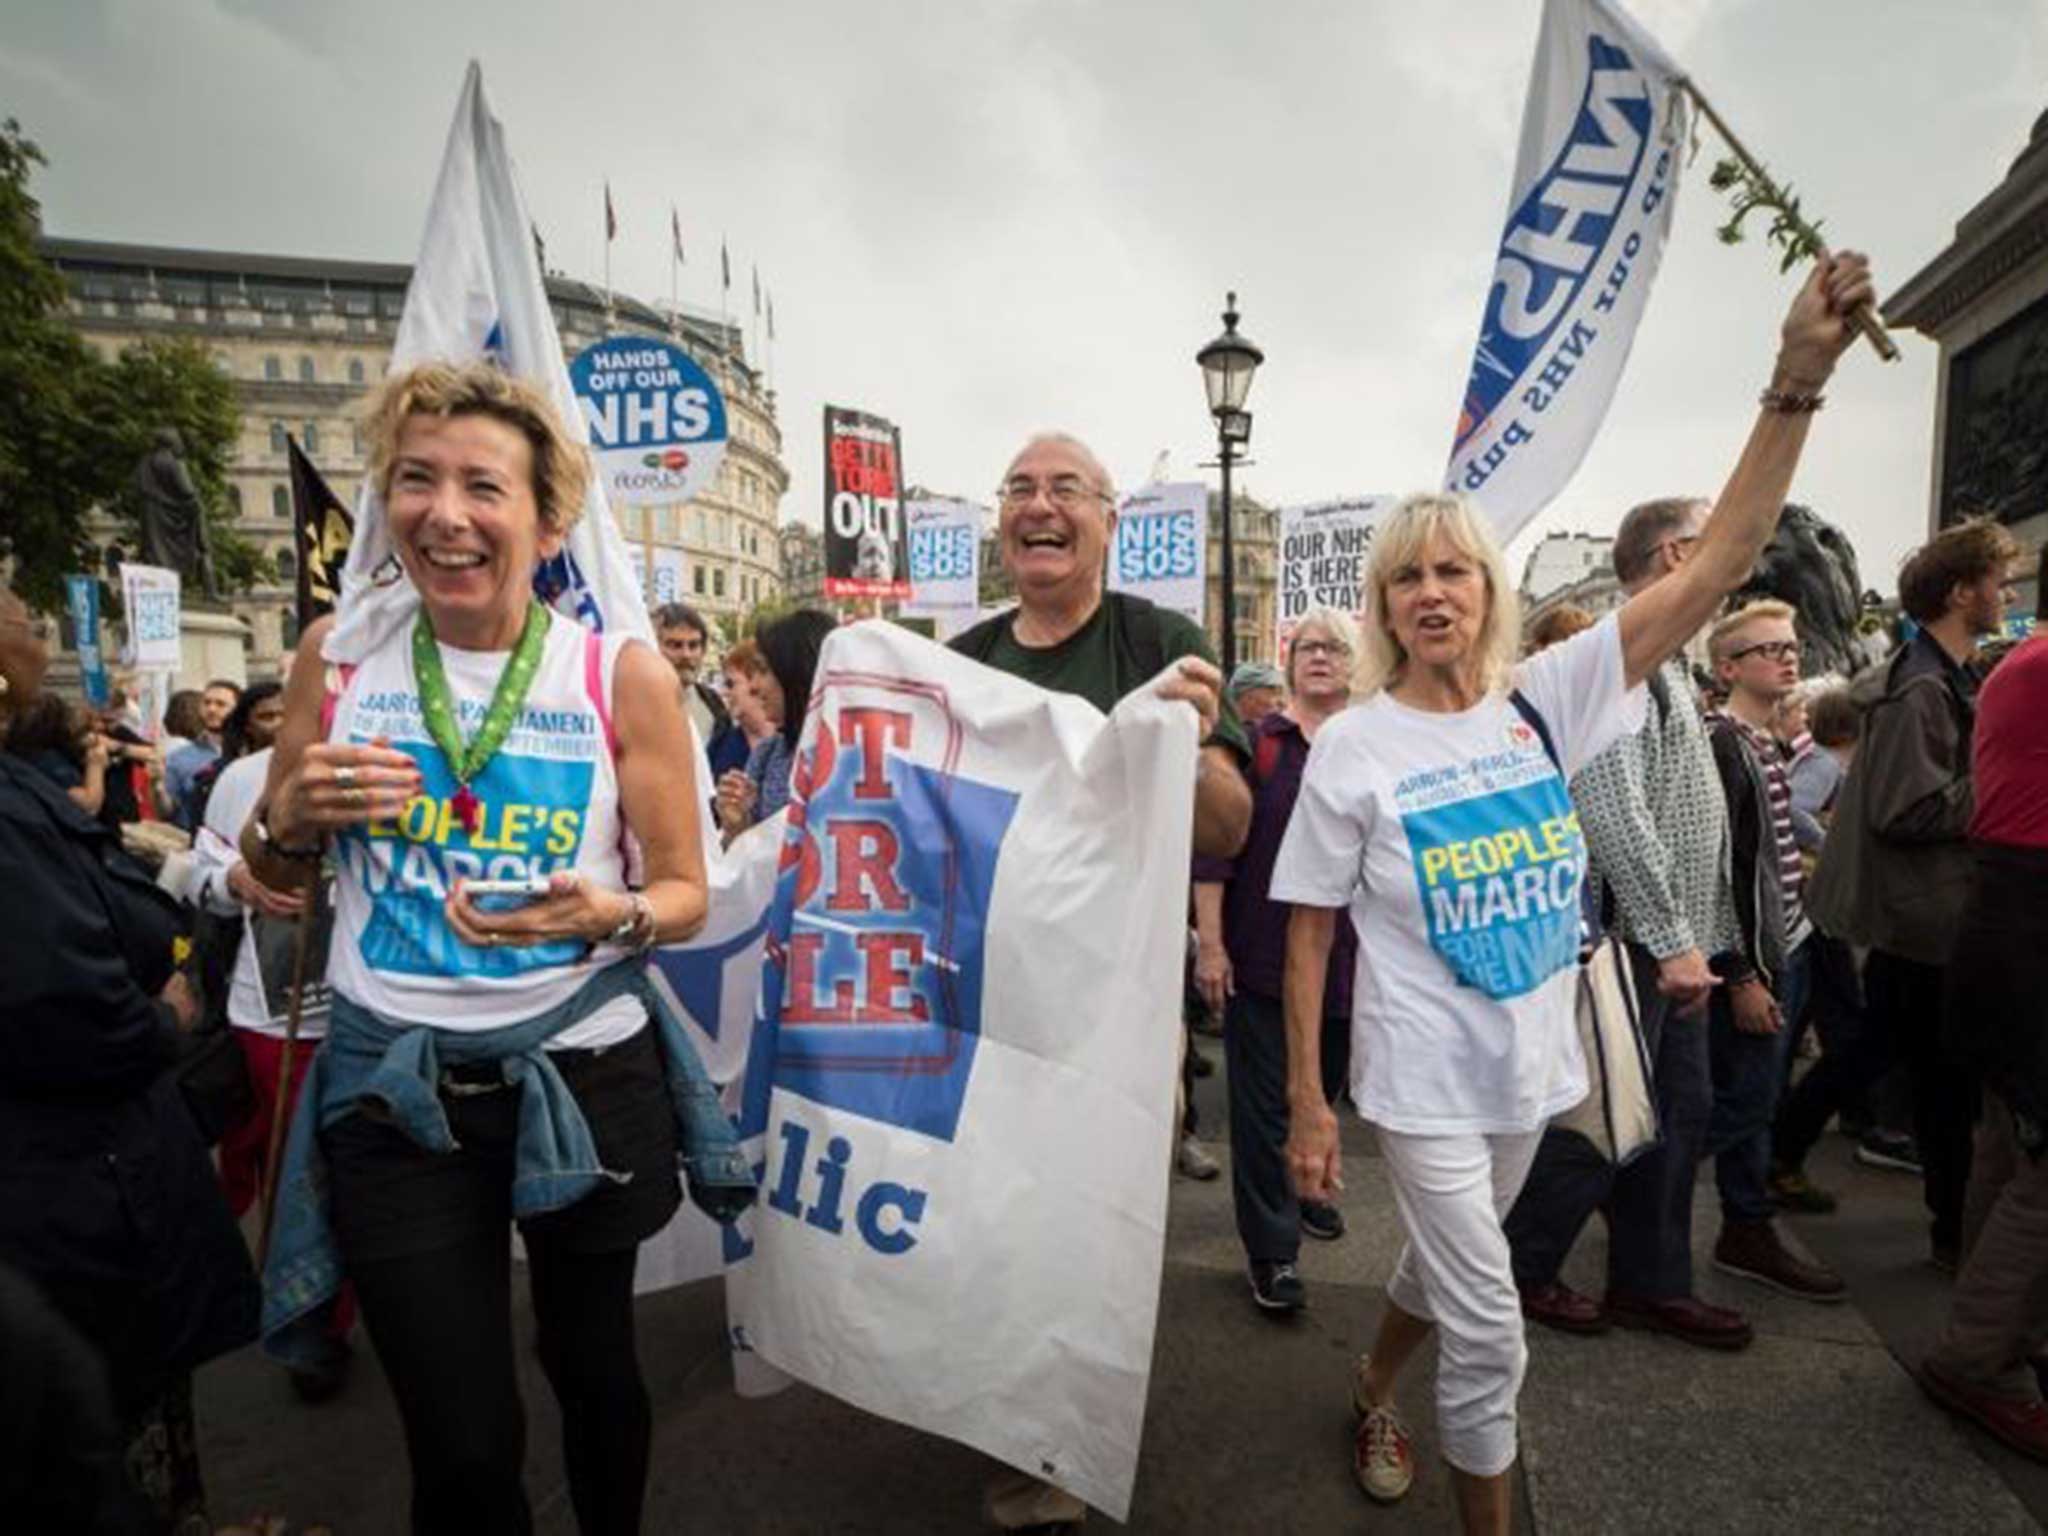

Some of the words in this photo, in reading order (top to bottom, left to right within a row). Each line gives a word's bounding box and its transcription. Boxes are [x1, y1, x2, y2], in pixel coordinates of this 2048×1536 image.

[592, 349, 671, 370] HANDS
[588, 372, 629, 391] OFF
[635, 369, 682, 388] OUR
[578, 386, 711, 444] NHS
[832, 491, 900, 541] OUT
[1121, 512, 1193, 550] NHS
[911, 525, 972, 556] NHS
[1283, 530, 1326, 562] OUR
[1332, 524, 1375, 554] NHS
[911, 553, 972, 580] SOS
[1121, 548, 1194, 578] SOS
[1283, 562, 1303, 590] IS
[1309, 555, 1364, 587] HERE
[1283, 589, 1308, 618] TO
[1315, 585, 1364, 611] STAY
[1396, 764, 1459, 797] ARROW
[368, 796, 580, 855] OPLE'S
